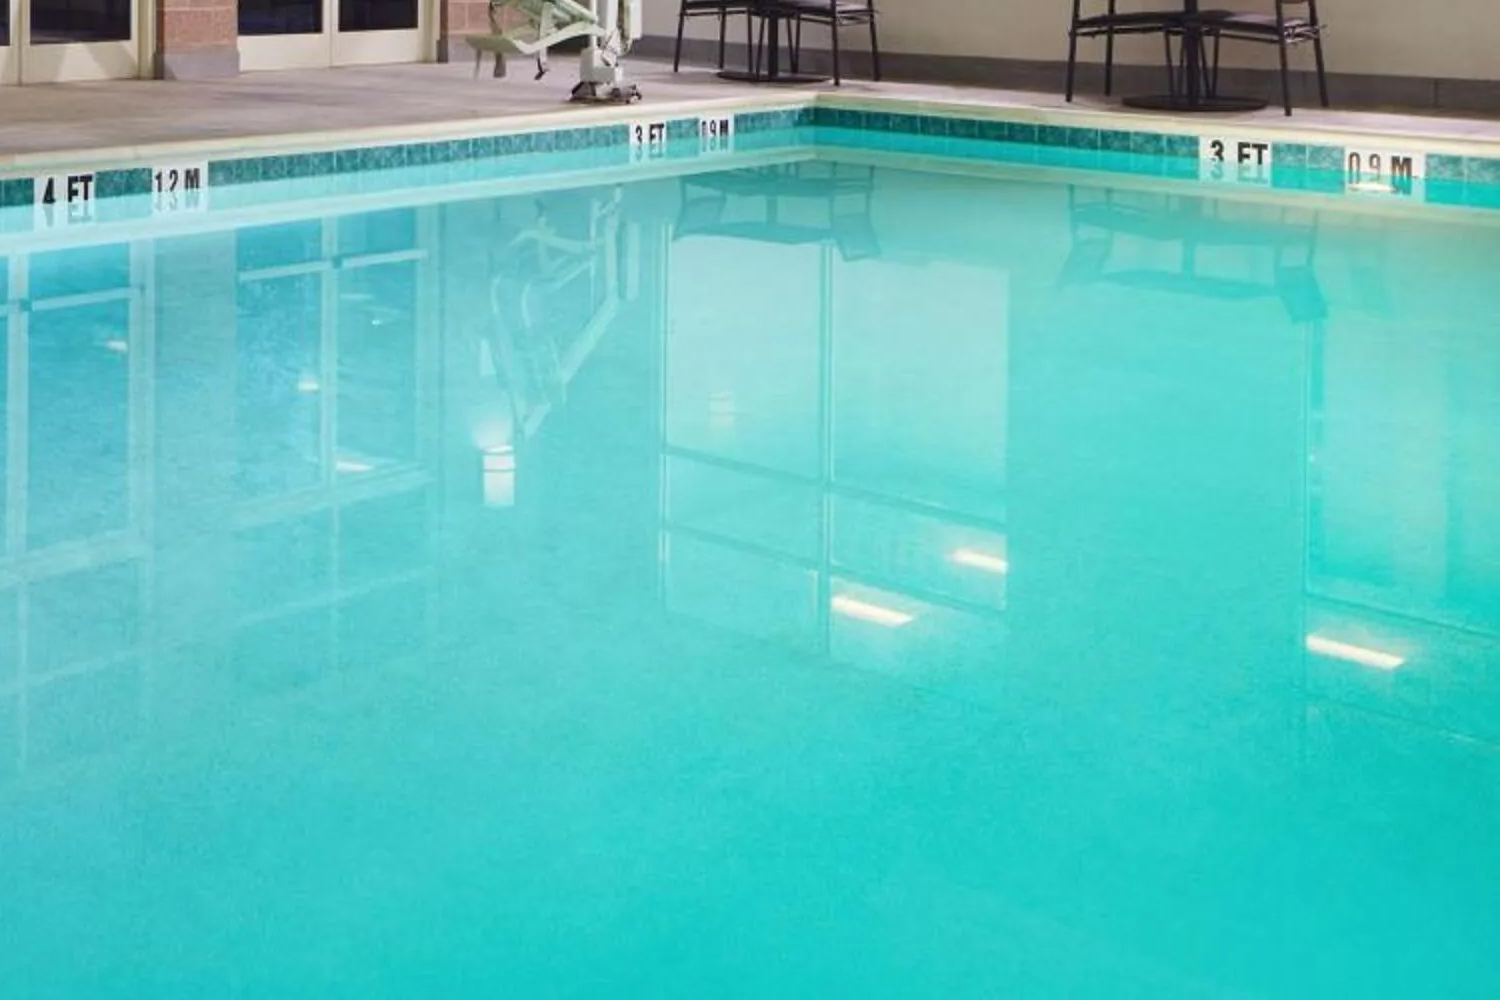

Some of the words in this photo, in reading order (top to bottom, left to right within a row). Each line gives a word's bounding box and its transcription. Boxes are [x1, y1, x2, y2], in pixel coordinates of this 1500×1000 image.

[648, 123, 665, 144] FT
[1211, 139, 1224, 163] 3
[1237, 141, 1269, 167] FT
[42, 177, 56, 205] 4
[67, 174, 93, 203] FT
[184, 167, 200, 190] M
